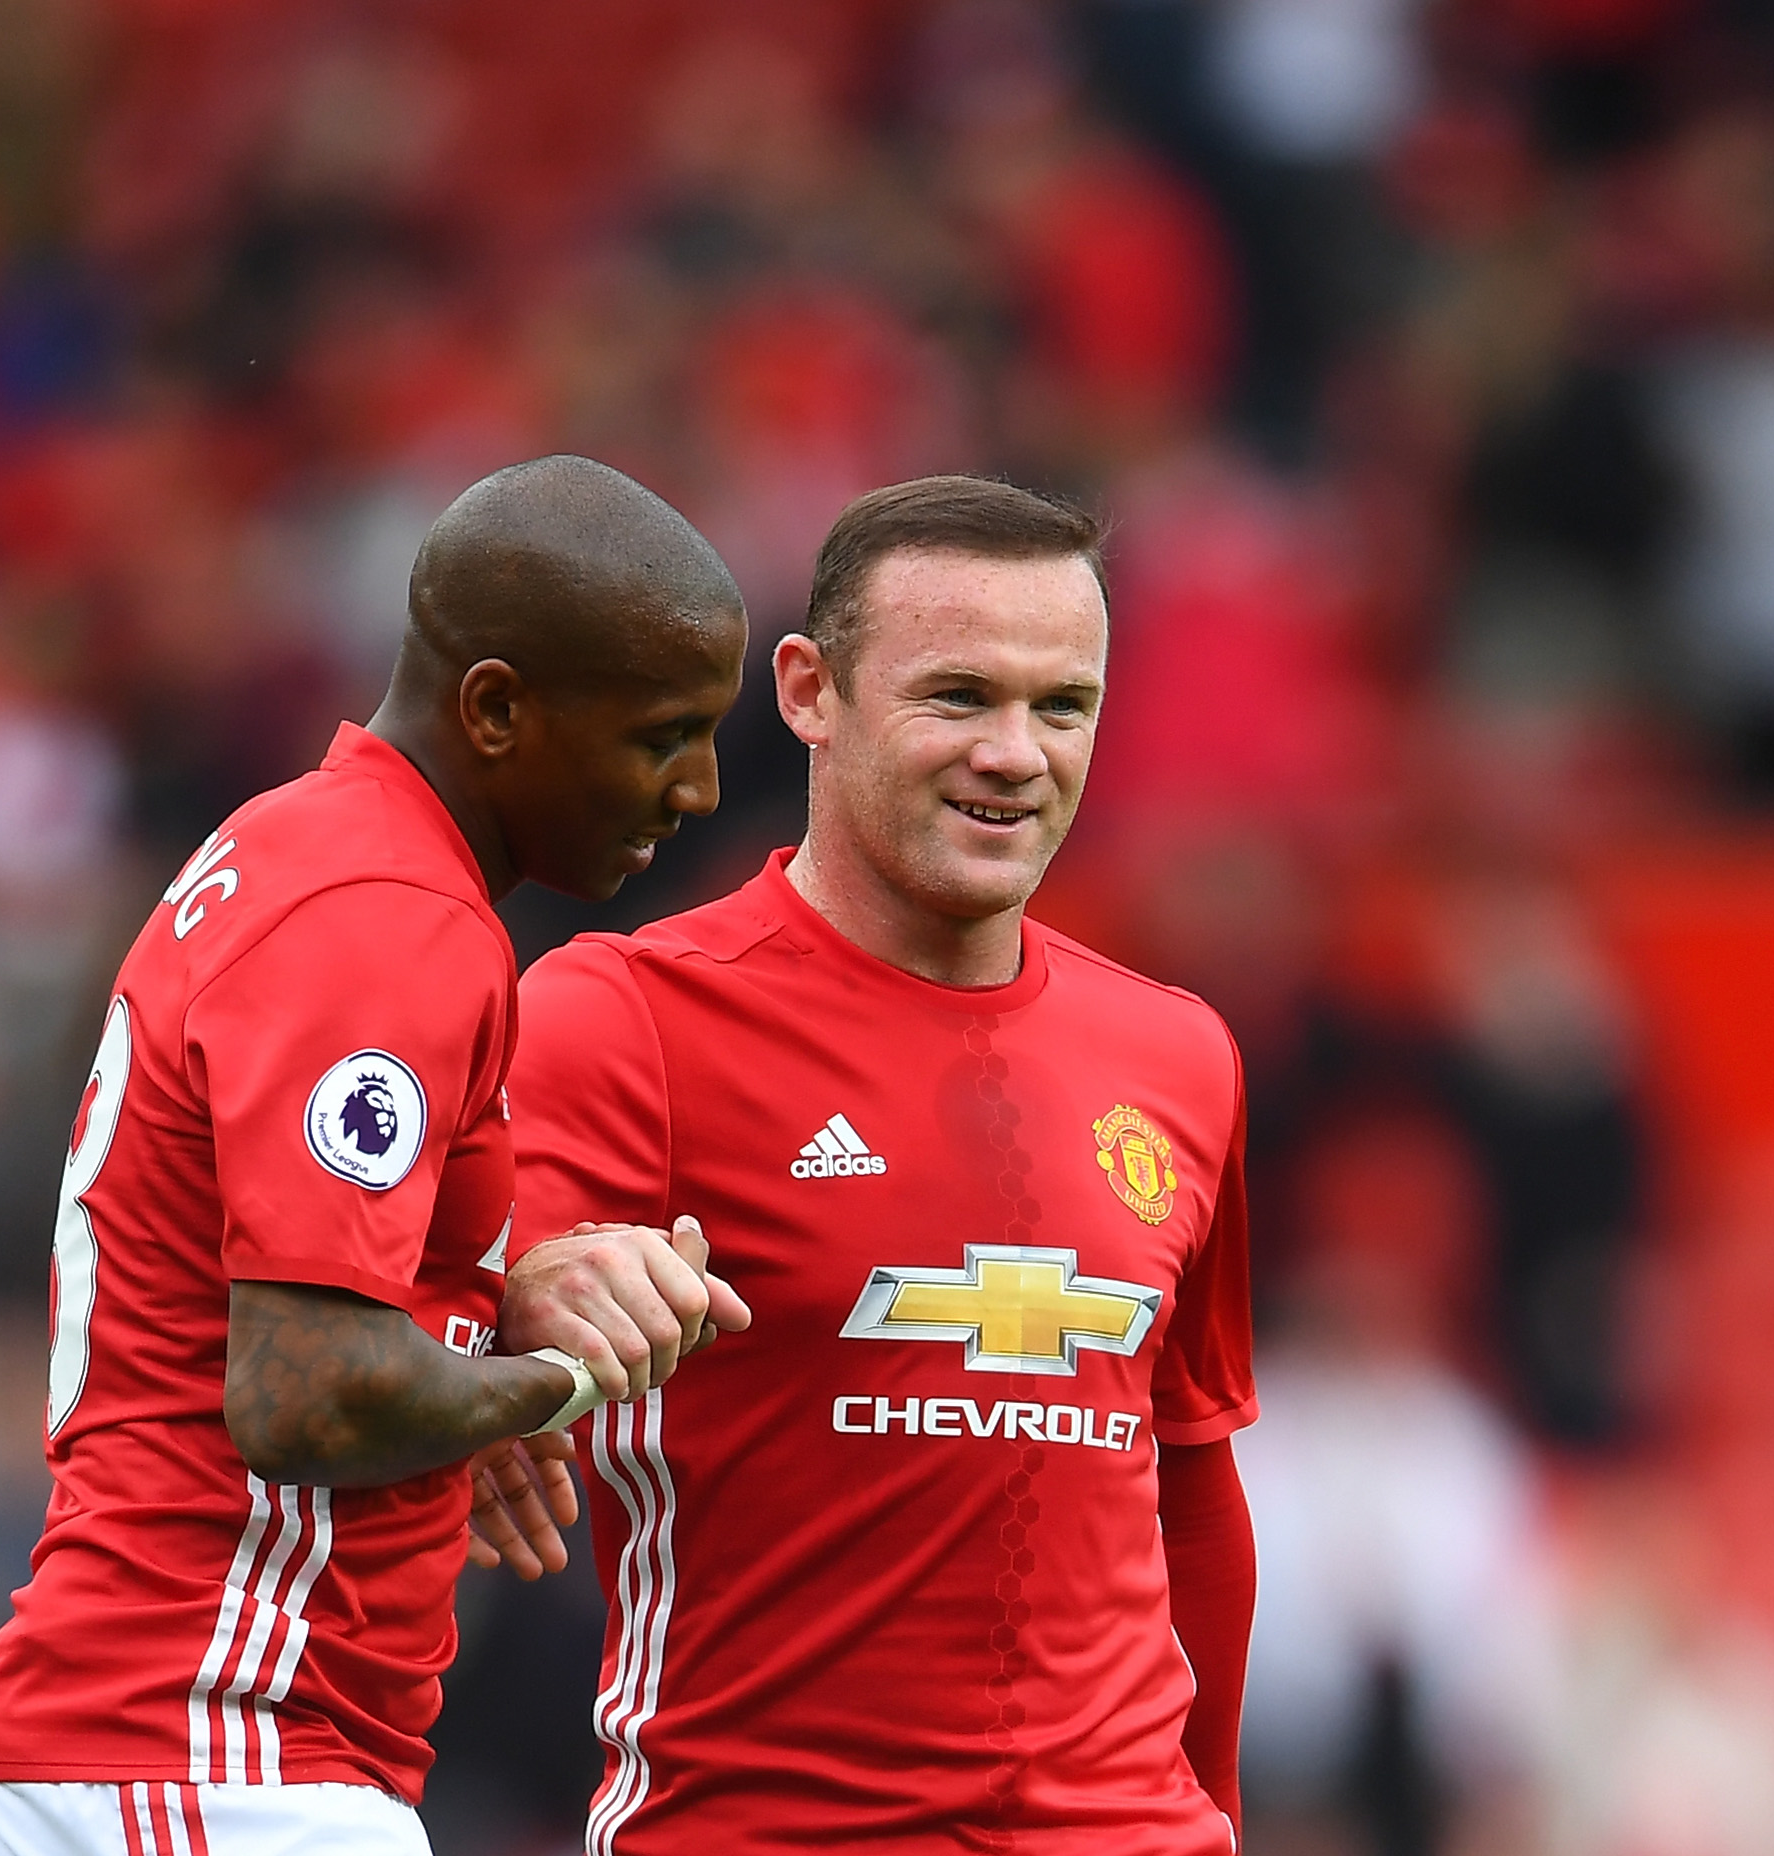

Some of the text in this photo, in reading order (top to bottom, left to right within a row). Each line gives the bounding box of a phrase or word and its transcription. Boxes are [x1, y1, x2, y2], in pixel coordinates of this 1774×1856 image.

[317, 1112, 369, 1175] Premier Leagu
[789, 1151, 888, 1179] adidas
[1124, 1189, 1167, 1217] UNITED
[832, 1395, 1142, 1452] CHEVROLET
